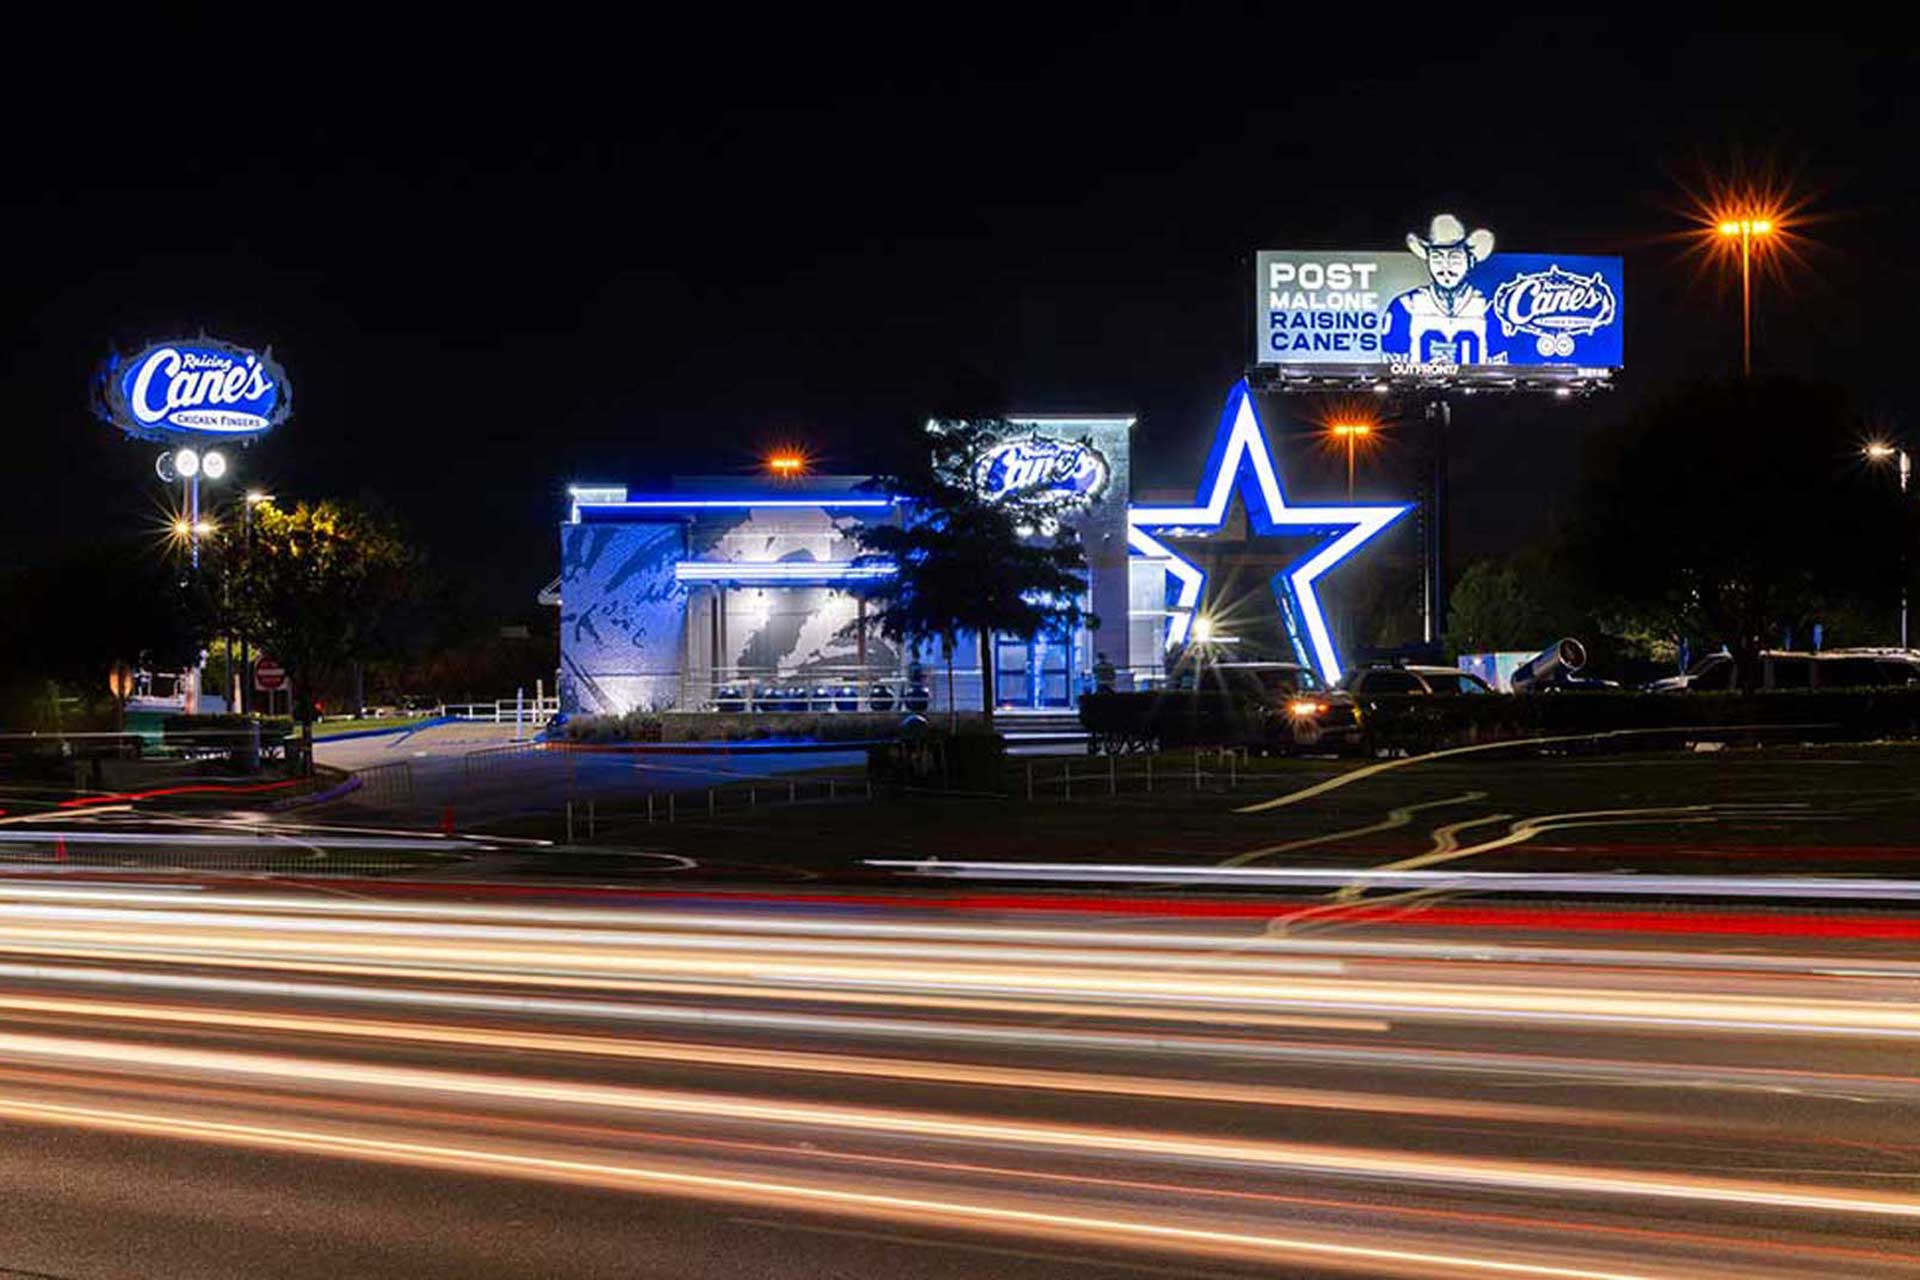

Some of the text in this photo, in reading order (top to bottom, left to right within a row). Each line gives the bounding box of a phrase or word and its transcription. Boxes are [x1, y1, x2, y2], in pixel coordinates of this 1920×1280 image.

[1269, 263, 1378, 290] POST
[1269, 291, 1379, 310] MALONE
[1269, 311, 1379, 329] RAISING
[1270, 332, 1378, 351] CANE'S
[132, 348, 273, 423] Cane's
